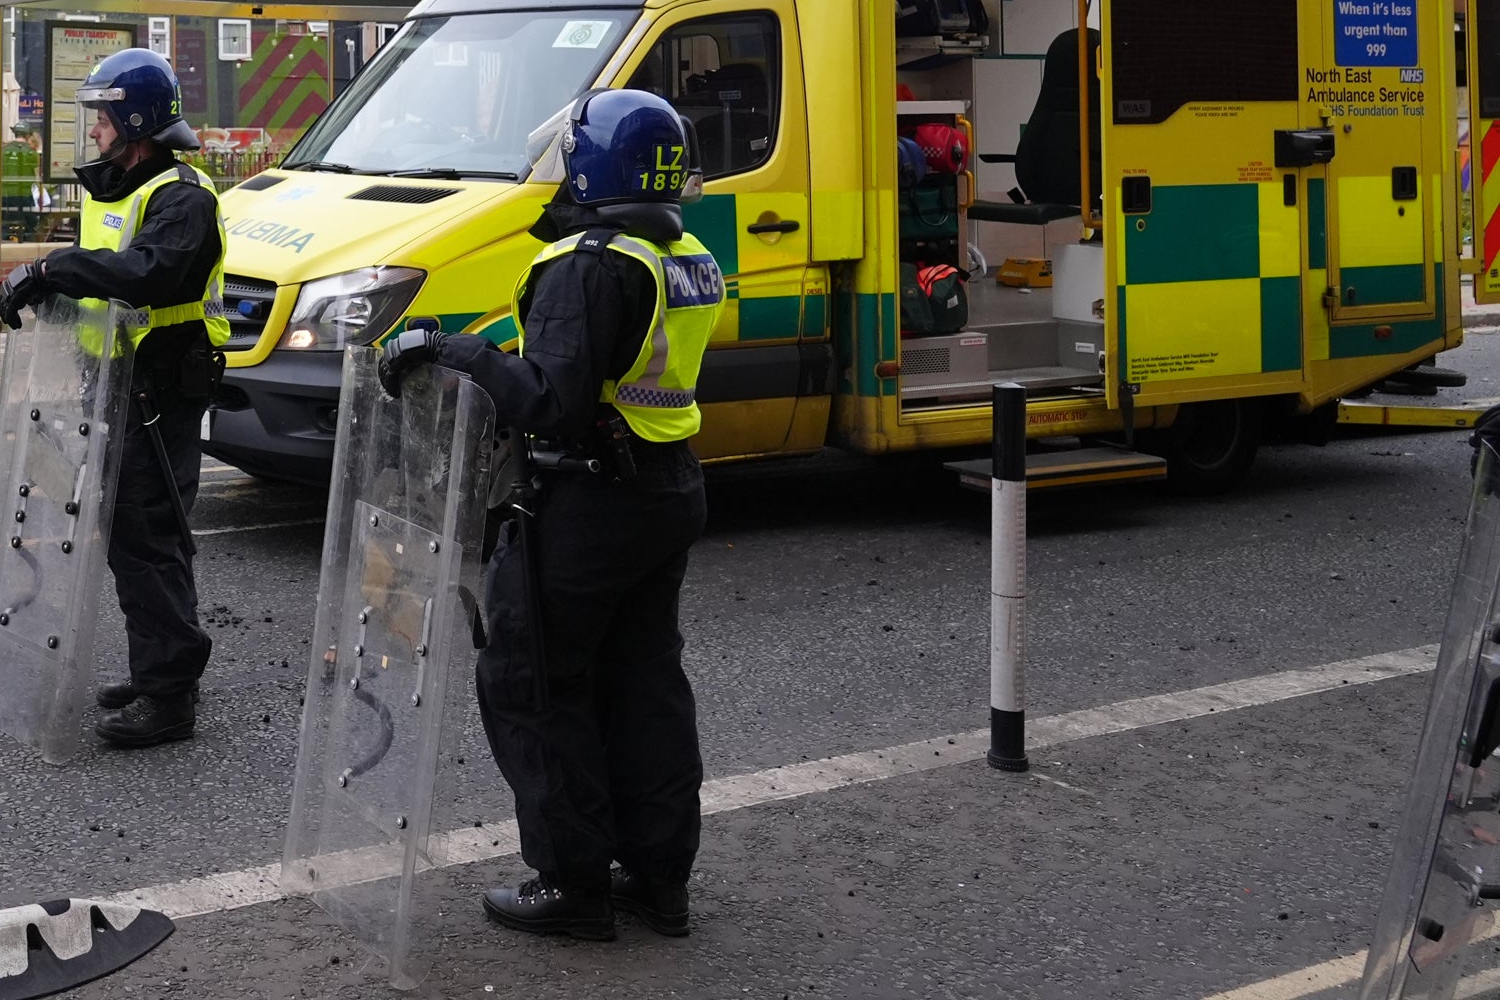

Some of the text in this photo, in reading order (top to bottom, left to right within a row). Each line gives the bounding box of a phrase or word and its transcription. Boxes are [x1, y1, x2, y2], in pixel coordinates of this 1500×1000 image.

[1338, 2, 1412, 16] When it's less
[64, 30, 118, 39] PUBLIC TRANSPORT
[1344, 23, 1407, 39] urgent than
[1366, 44, 1386, 56] 999
[1306, 68, 1423, 83] North East NHS
[1308, 88, 1424, 102] Ambulance Service
[1348, 105, 1398, 116] Foundation
[1402, 105, 1424, 116] Trust
[656, 146, 684, 170] LZ
[640, 171, 688, 190] 1892
[104, 215, 121, 227] POLICE
[666, 262, 718, 299] POLICE
[1029, 412, 1069, 424] AUTOMATIC
